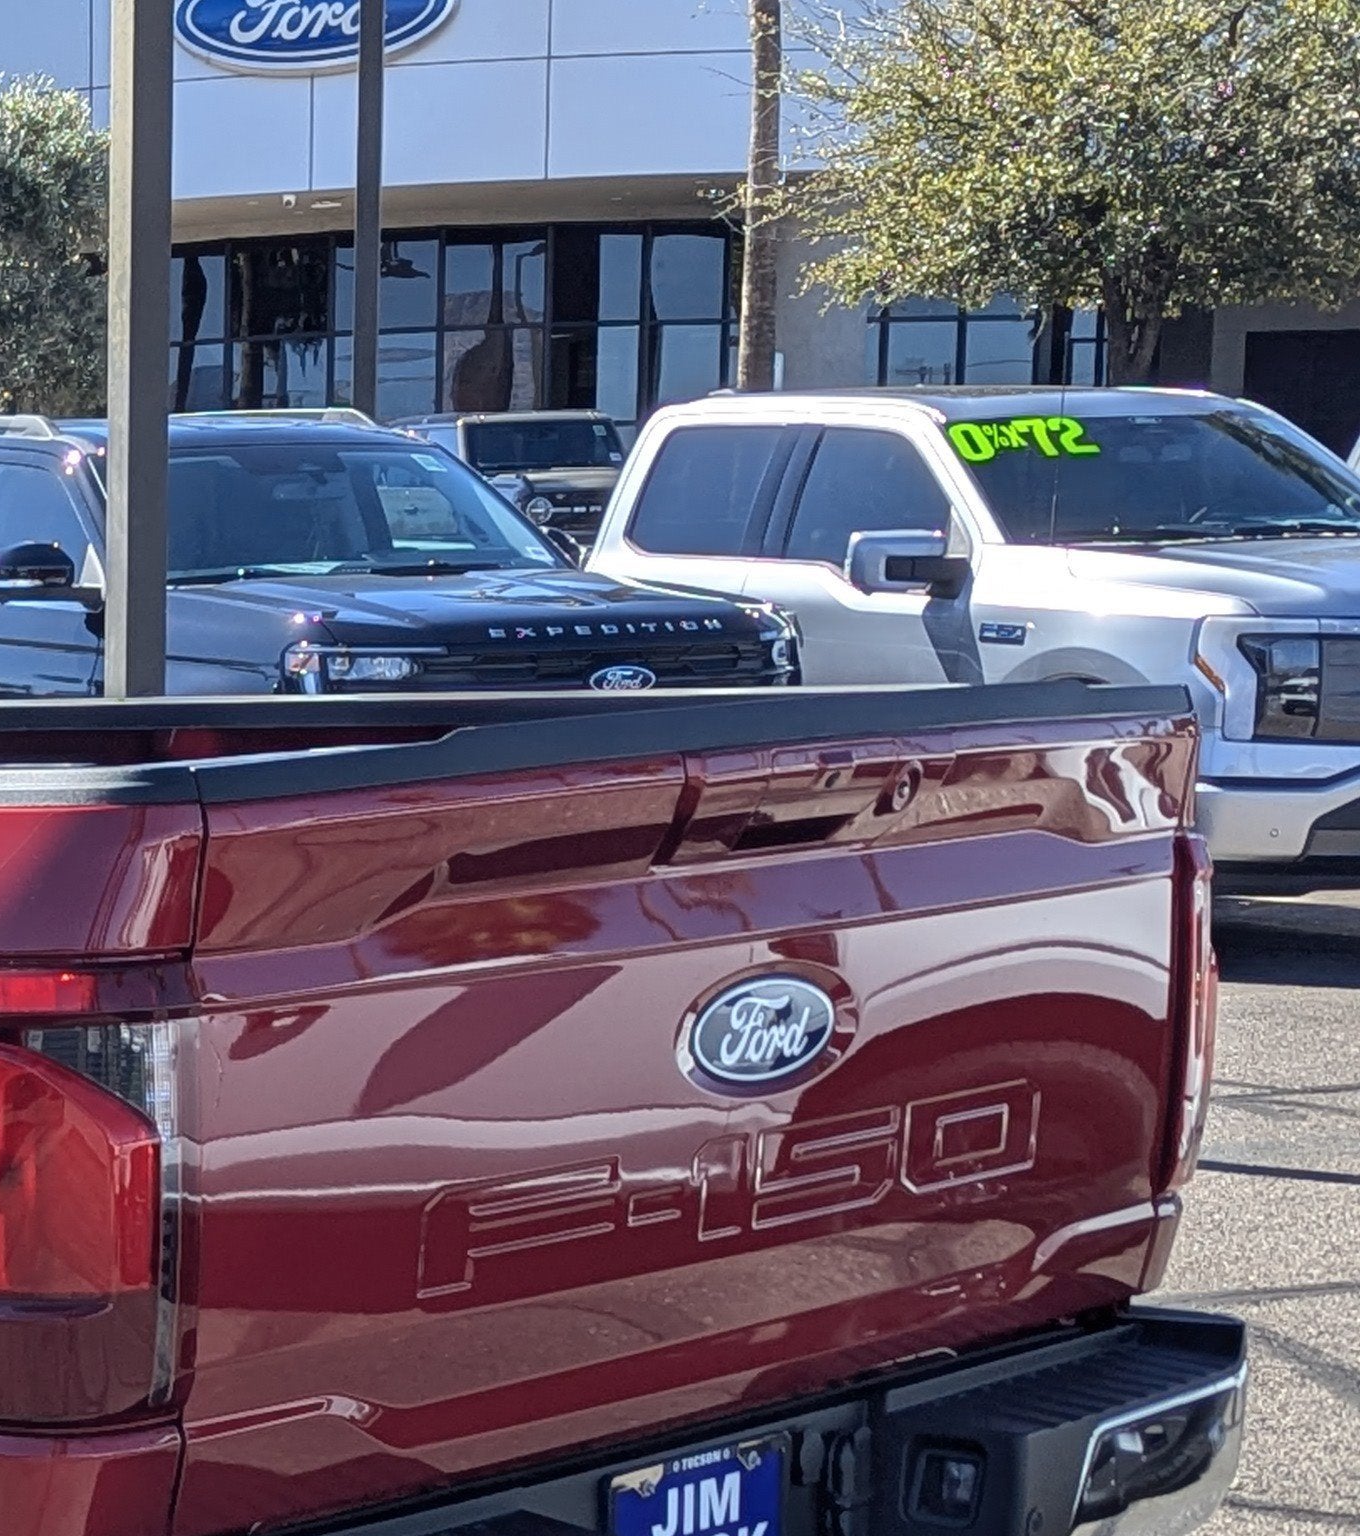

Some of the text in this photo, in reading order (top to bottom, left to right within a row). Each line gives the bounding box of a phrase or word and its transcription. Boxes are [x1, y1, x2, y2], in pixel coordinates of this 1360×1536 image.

[230, 0, 362, 43] For
[488, 618, 723, 639] EXPEDITION
[602, 670, 644, 690] Ford
[720, 994, 811, 1066] Ford
[416, 1078, 1042, 1299] F-150
[681, 1450, 722, 1471] TUCSON
